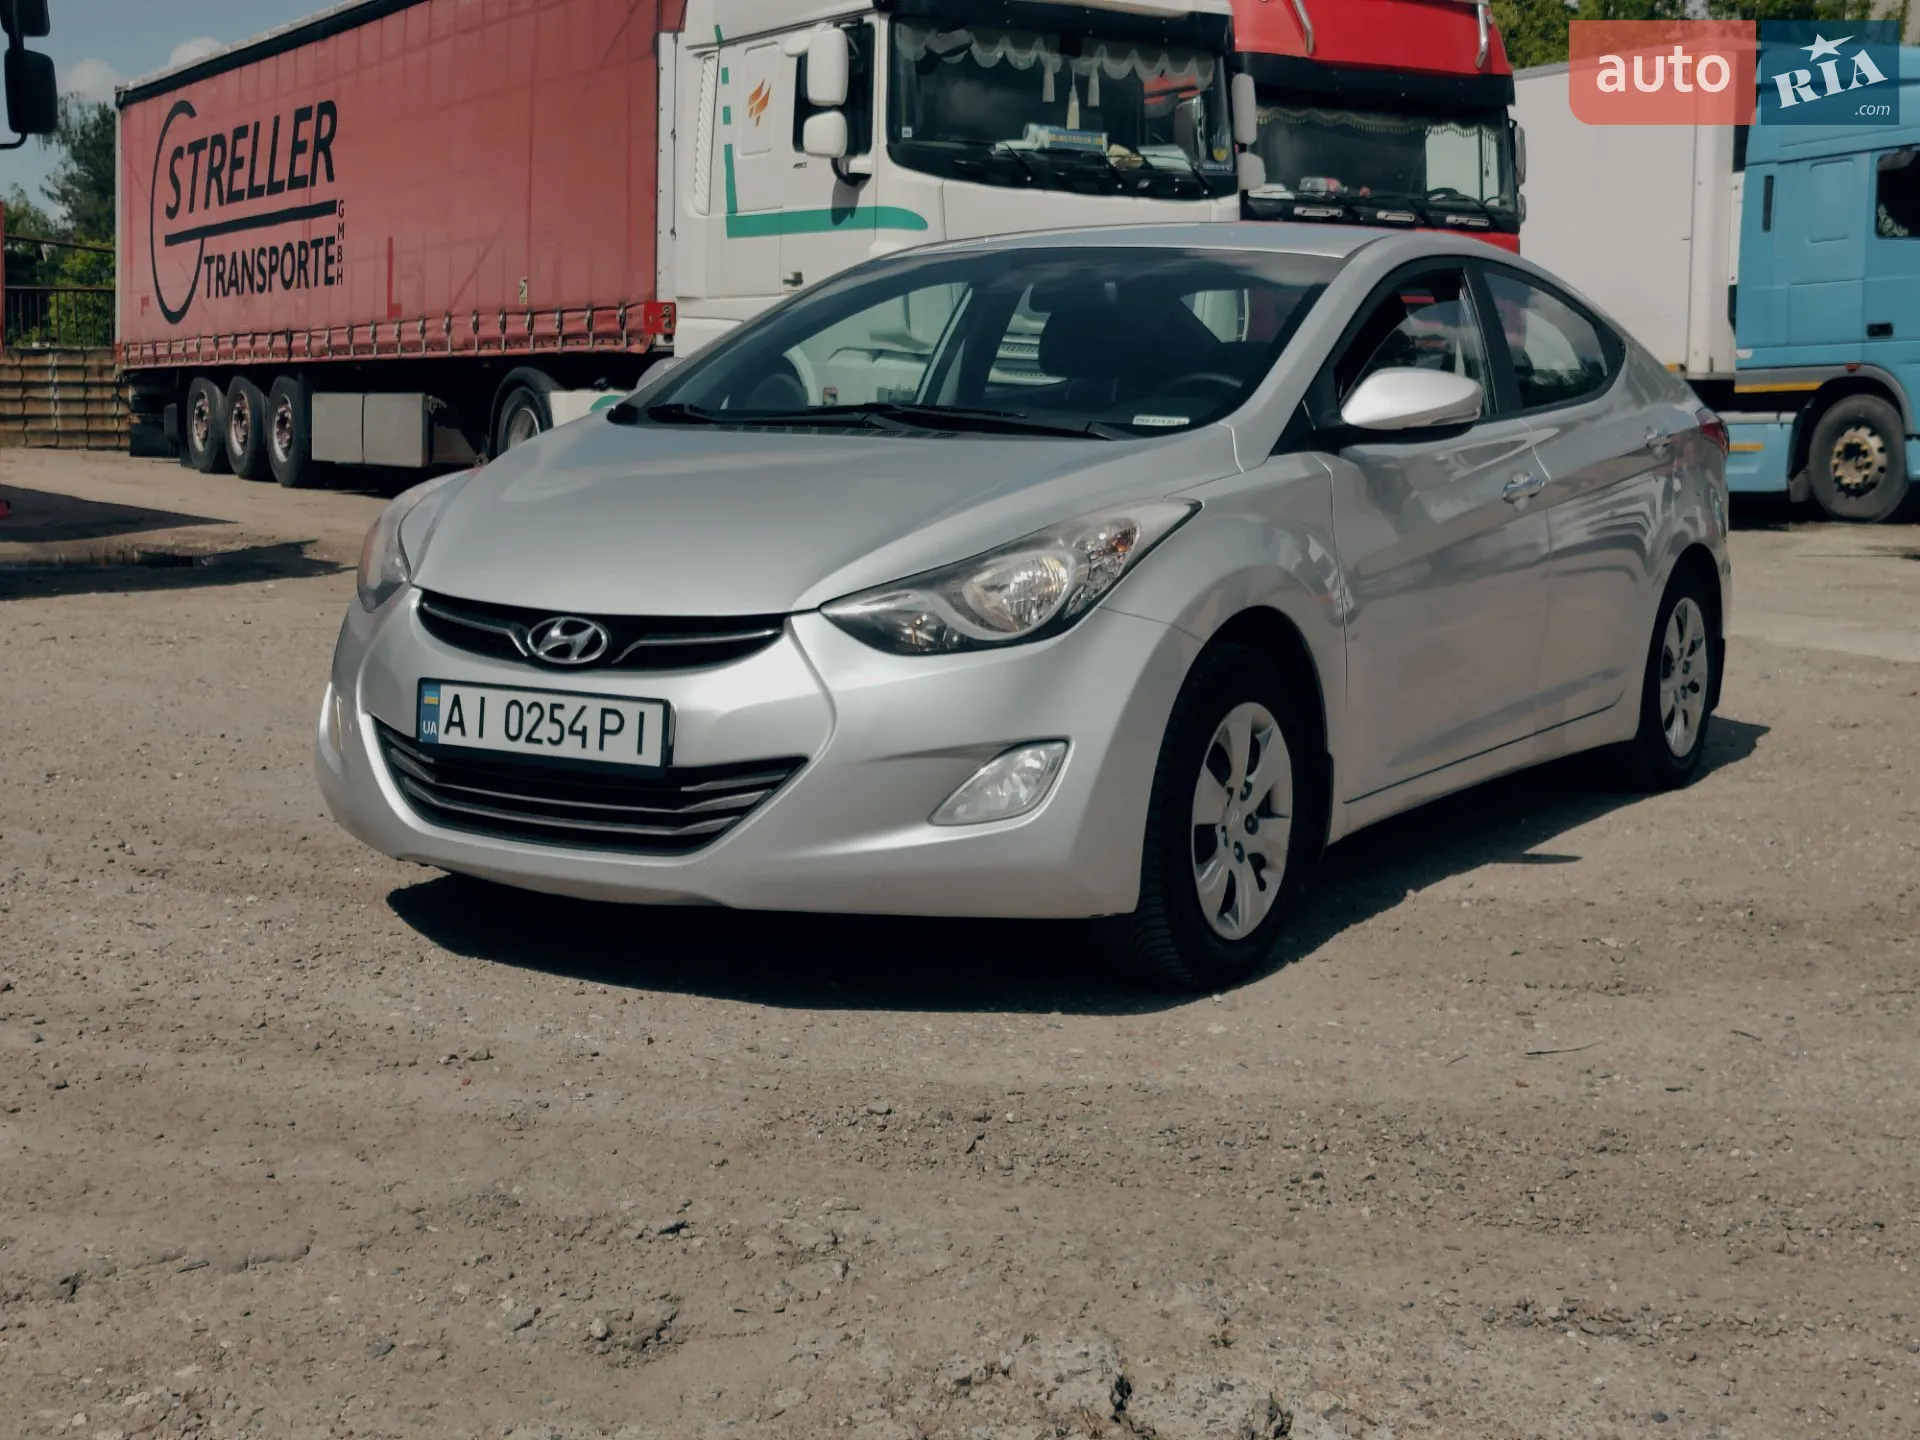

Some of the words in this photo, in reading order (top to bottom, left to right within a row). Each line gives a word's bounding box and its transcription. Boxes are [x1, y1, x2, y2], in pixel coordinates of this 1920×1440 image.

[165, 100, 338, 220] STRELLER
[203, 236, 336, 299] TRANSPORTE
[422, 720, 438, 736] UA
